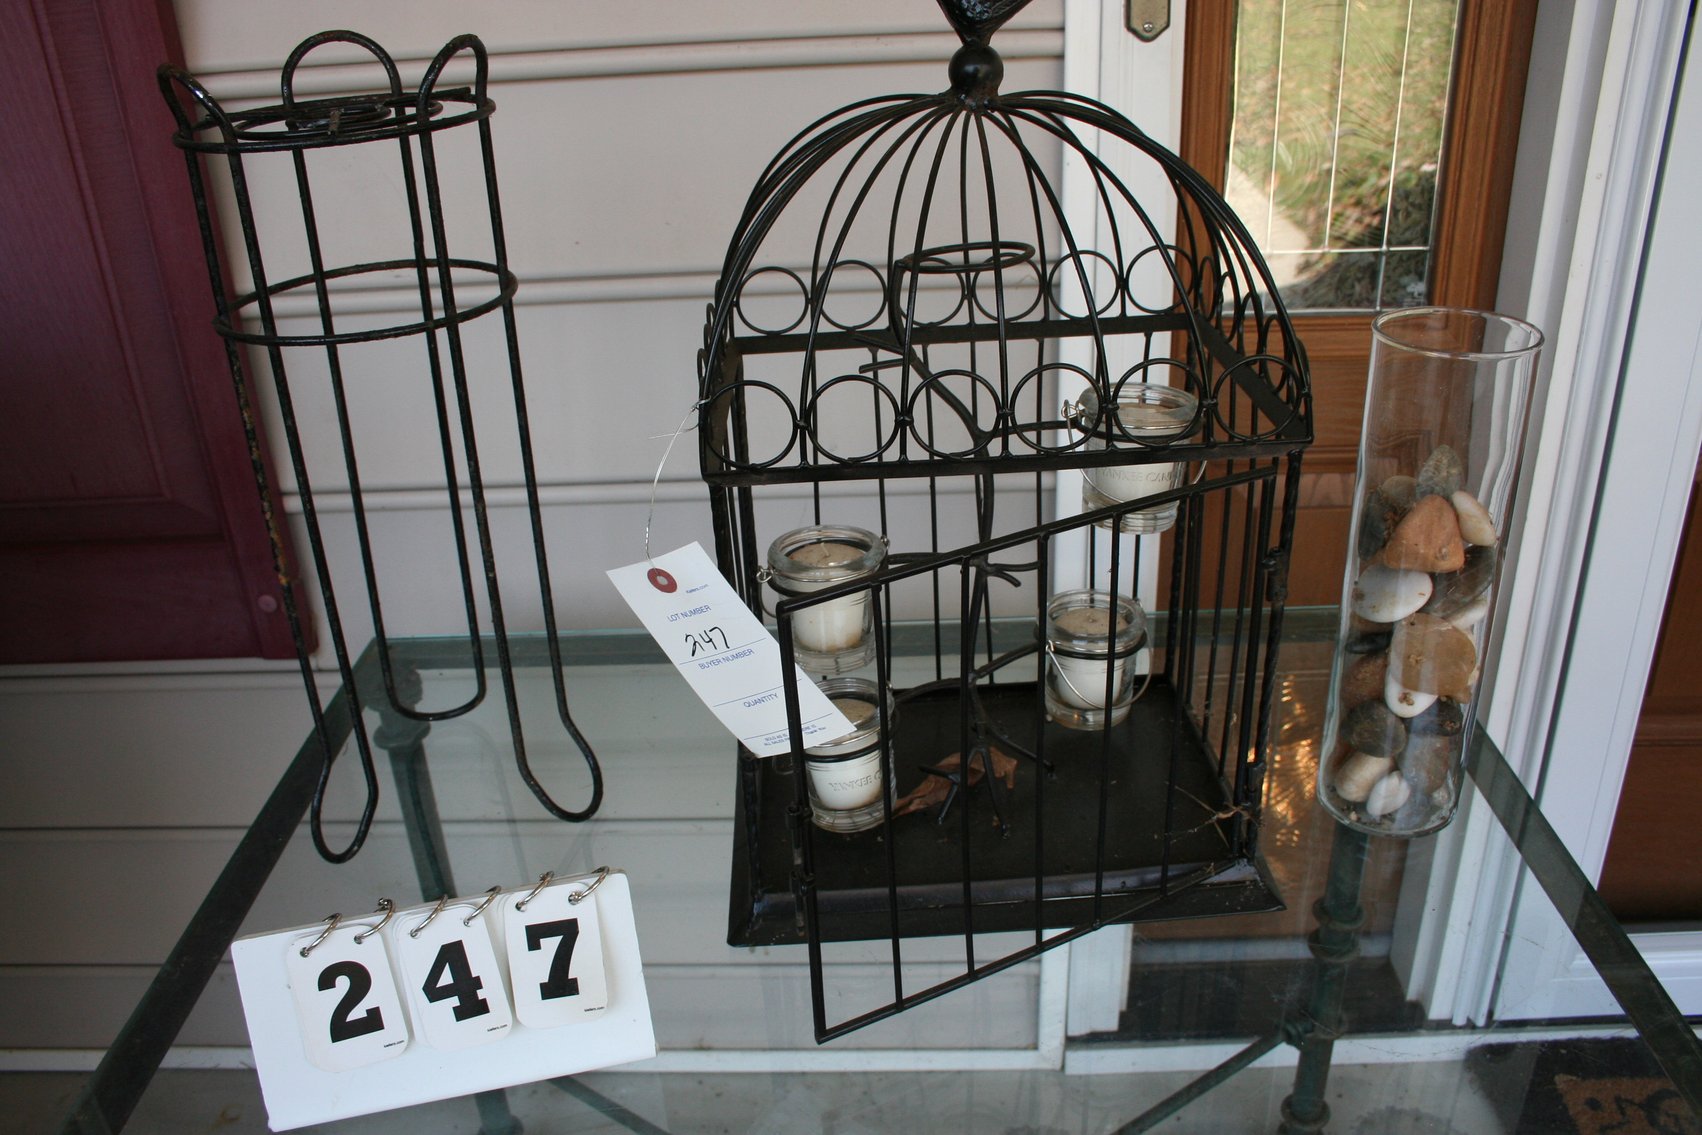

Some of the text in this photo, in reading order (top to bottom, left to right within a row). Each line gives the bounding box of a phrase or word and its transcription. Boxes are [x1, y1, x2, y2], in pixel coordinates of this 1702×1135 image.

[667, 604, 712, 622] LOT NUMBER
[685, 626, 730, 657] 247
[698, 648, 755, 670] BUYER NUMBER
[743, 692, 779, 708] QUANTITY
